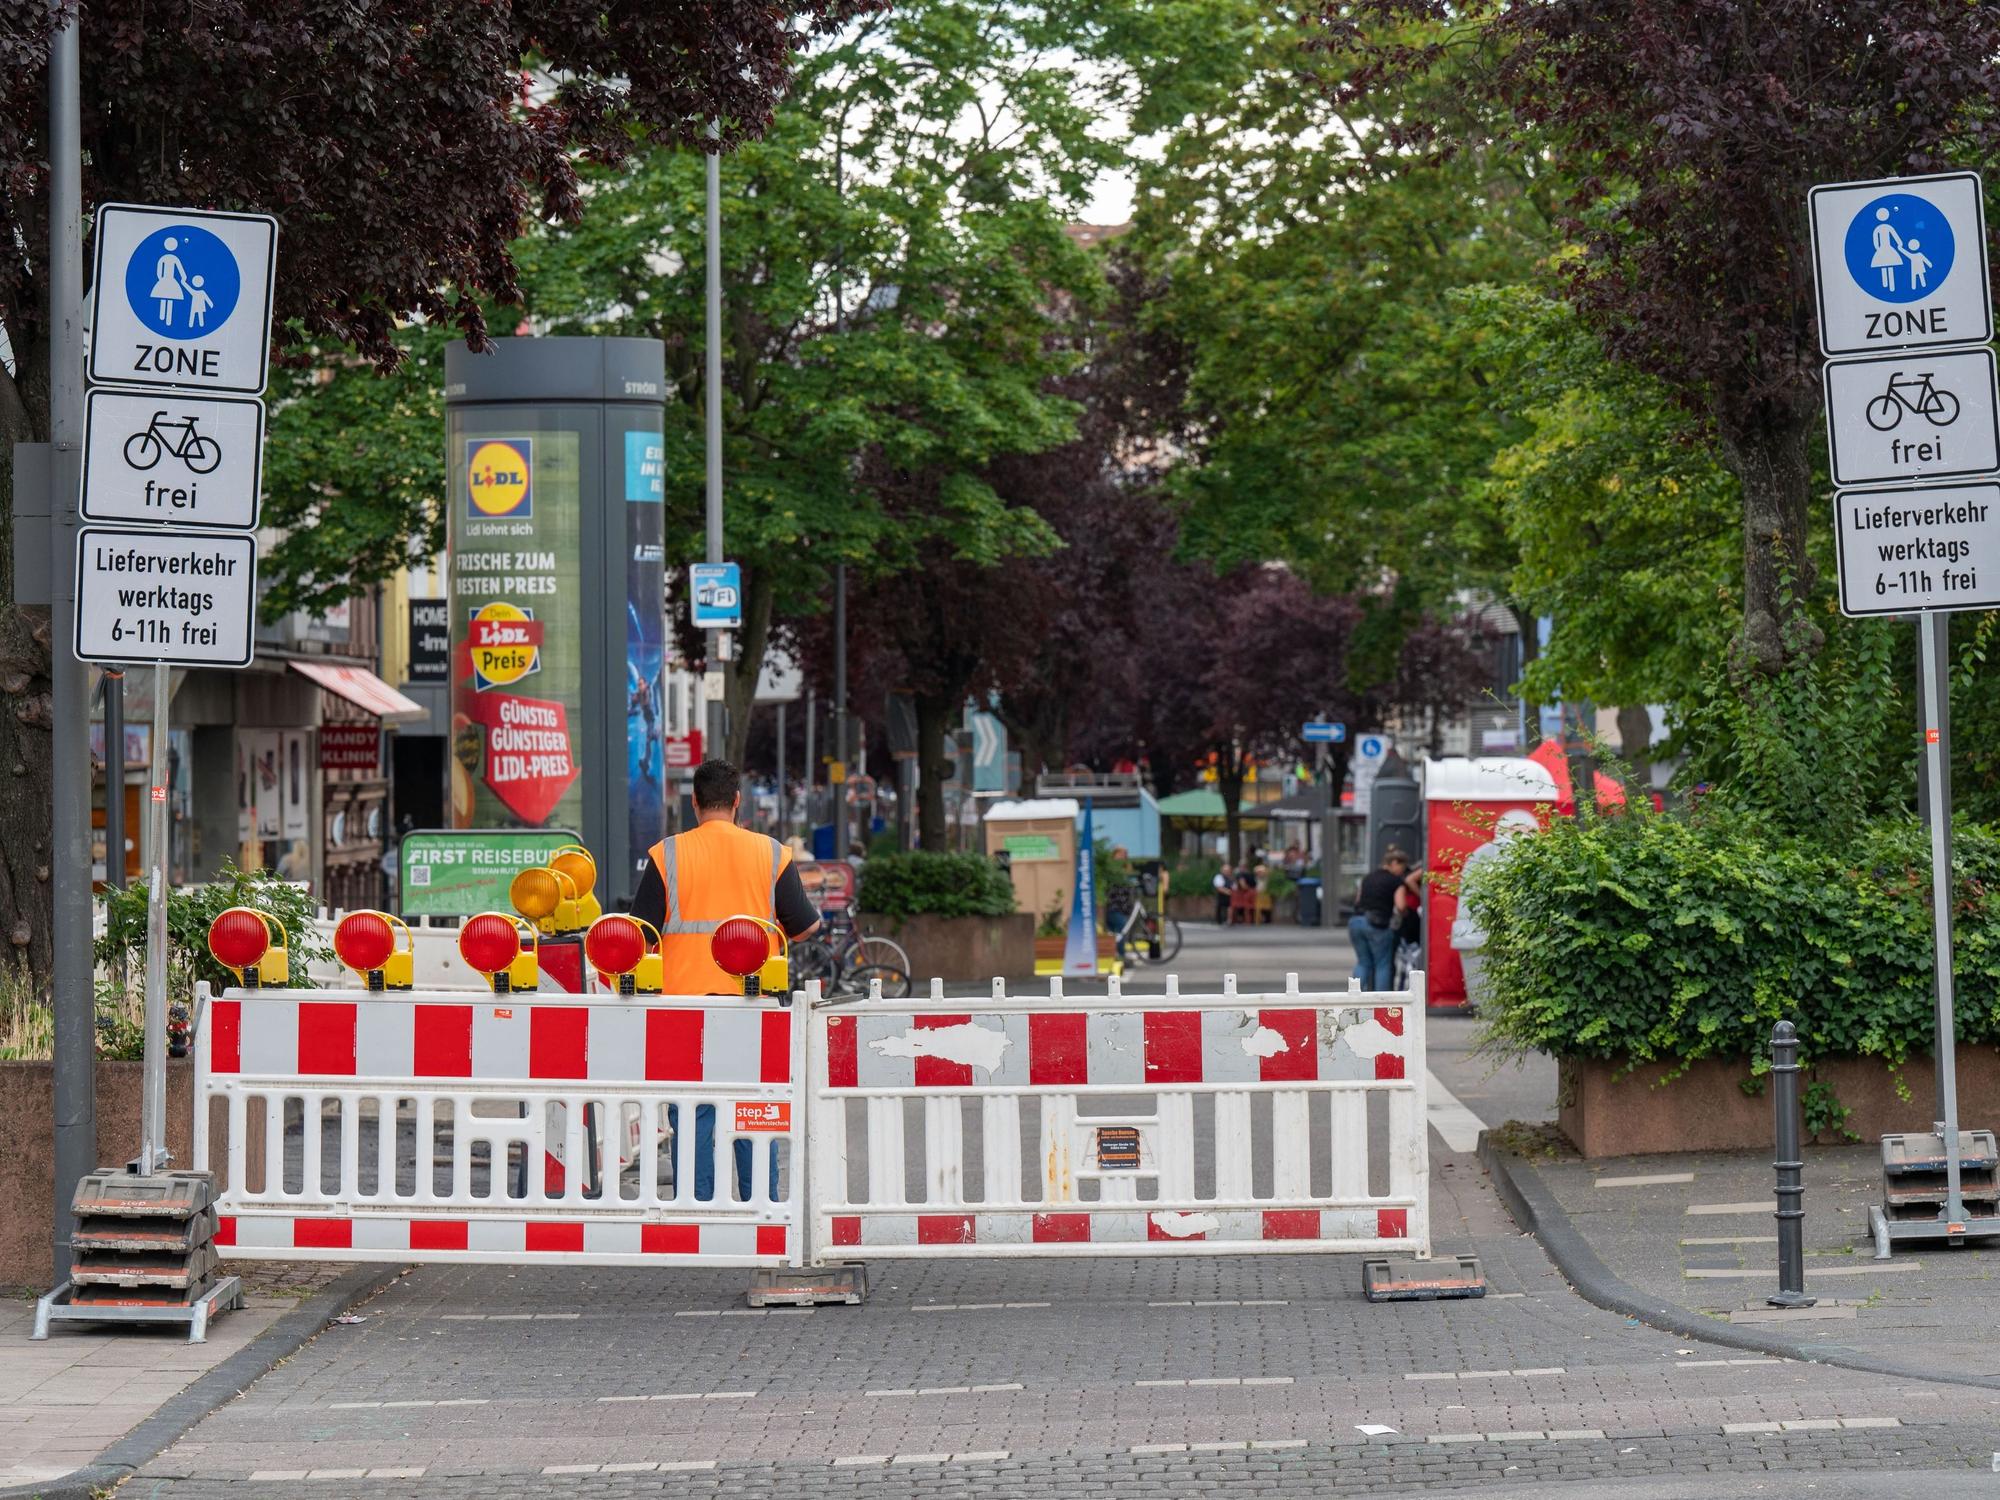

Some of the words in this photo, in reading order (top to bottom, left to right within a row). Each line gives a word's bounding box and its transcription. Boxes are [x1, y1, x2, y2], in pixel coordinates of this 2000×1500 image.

[1865, 307, 1947, 339] ZONE
[134, 344, 220, 377] ZONE
[1891, 435, 1942, 464] frei
[145, 480, 197, 509] frei
[1854, 501, 1988, 530] Lieferverkehr
[466, 524, 481, 536] Lidl
[482, 524, 508, 536] lohnt
[511, 523, 533, 535] sich
[96, 547, 237, 577] Lieferverkehr
[515, 551, 555, 570] ZUM
[1878, 537, 1970, 563] werktags
[503, 576, 556, 595] PREIS
[1875, 570, 1932, 595] 6-11h
[1943, 567, 1976, 591] frei
[119, 585, 213, 616] werktags
[112, 618, 170, 644] 6-11h
[182, 621, 217, 645] frei
[483, 651, 526, 671] Preis
[501, 700, 557, 727] GÜNSTIG
[322, 733, 377, 744] HANDY
[492, 726, 567, 752] GÜNSTIGER
[322, 752, 376, 763] KLINIK
[494, 755, 569, 782] LIDL-PREIS
[407, 849, 467, 864] FIRST
[736, 1106, 762, 1120] step
